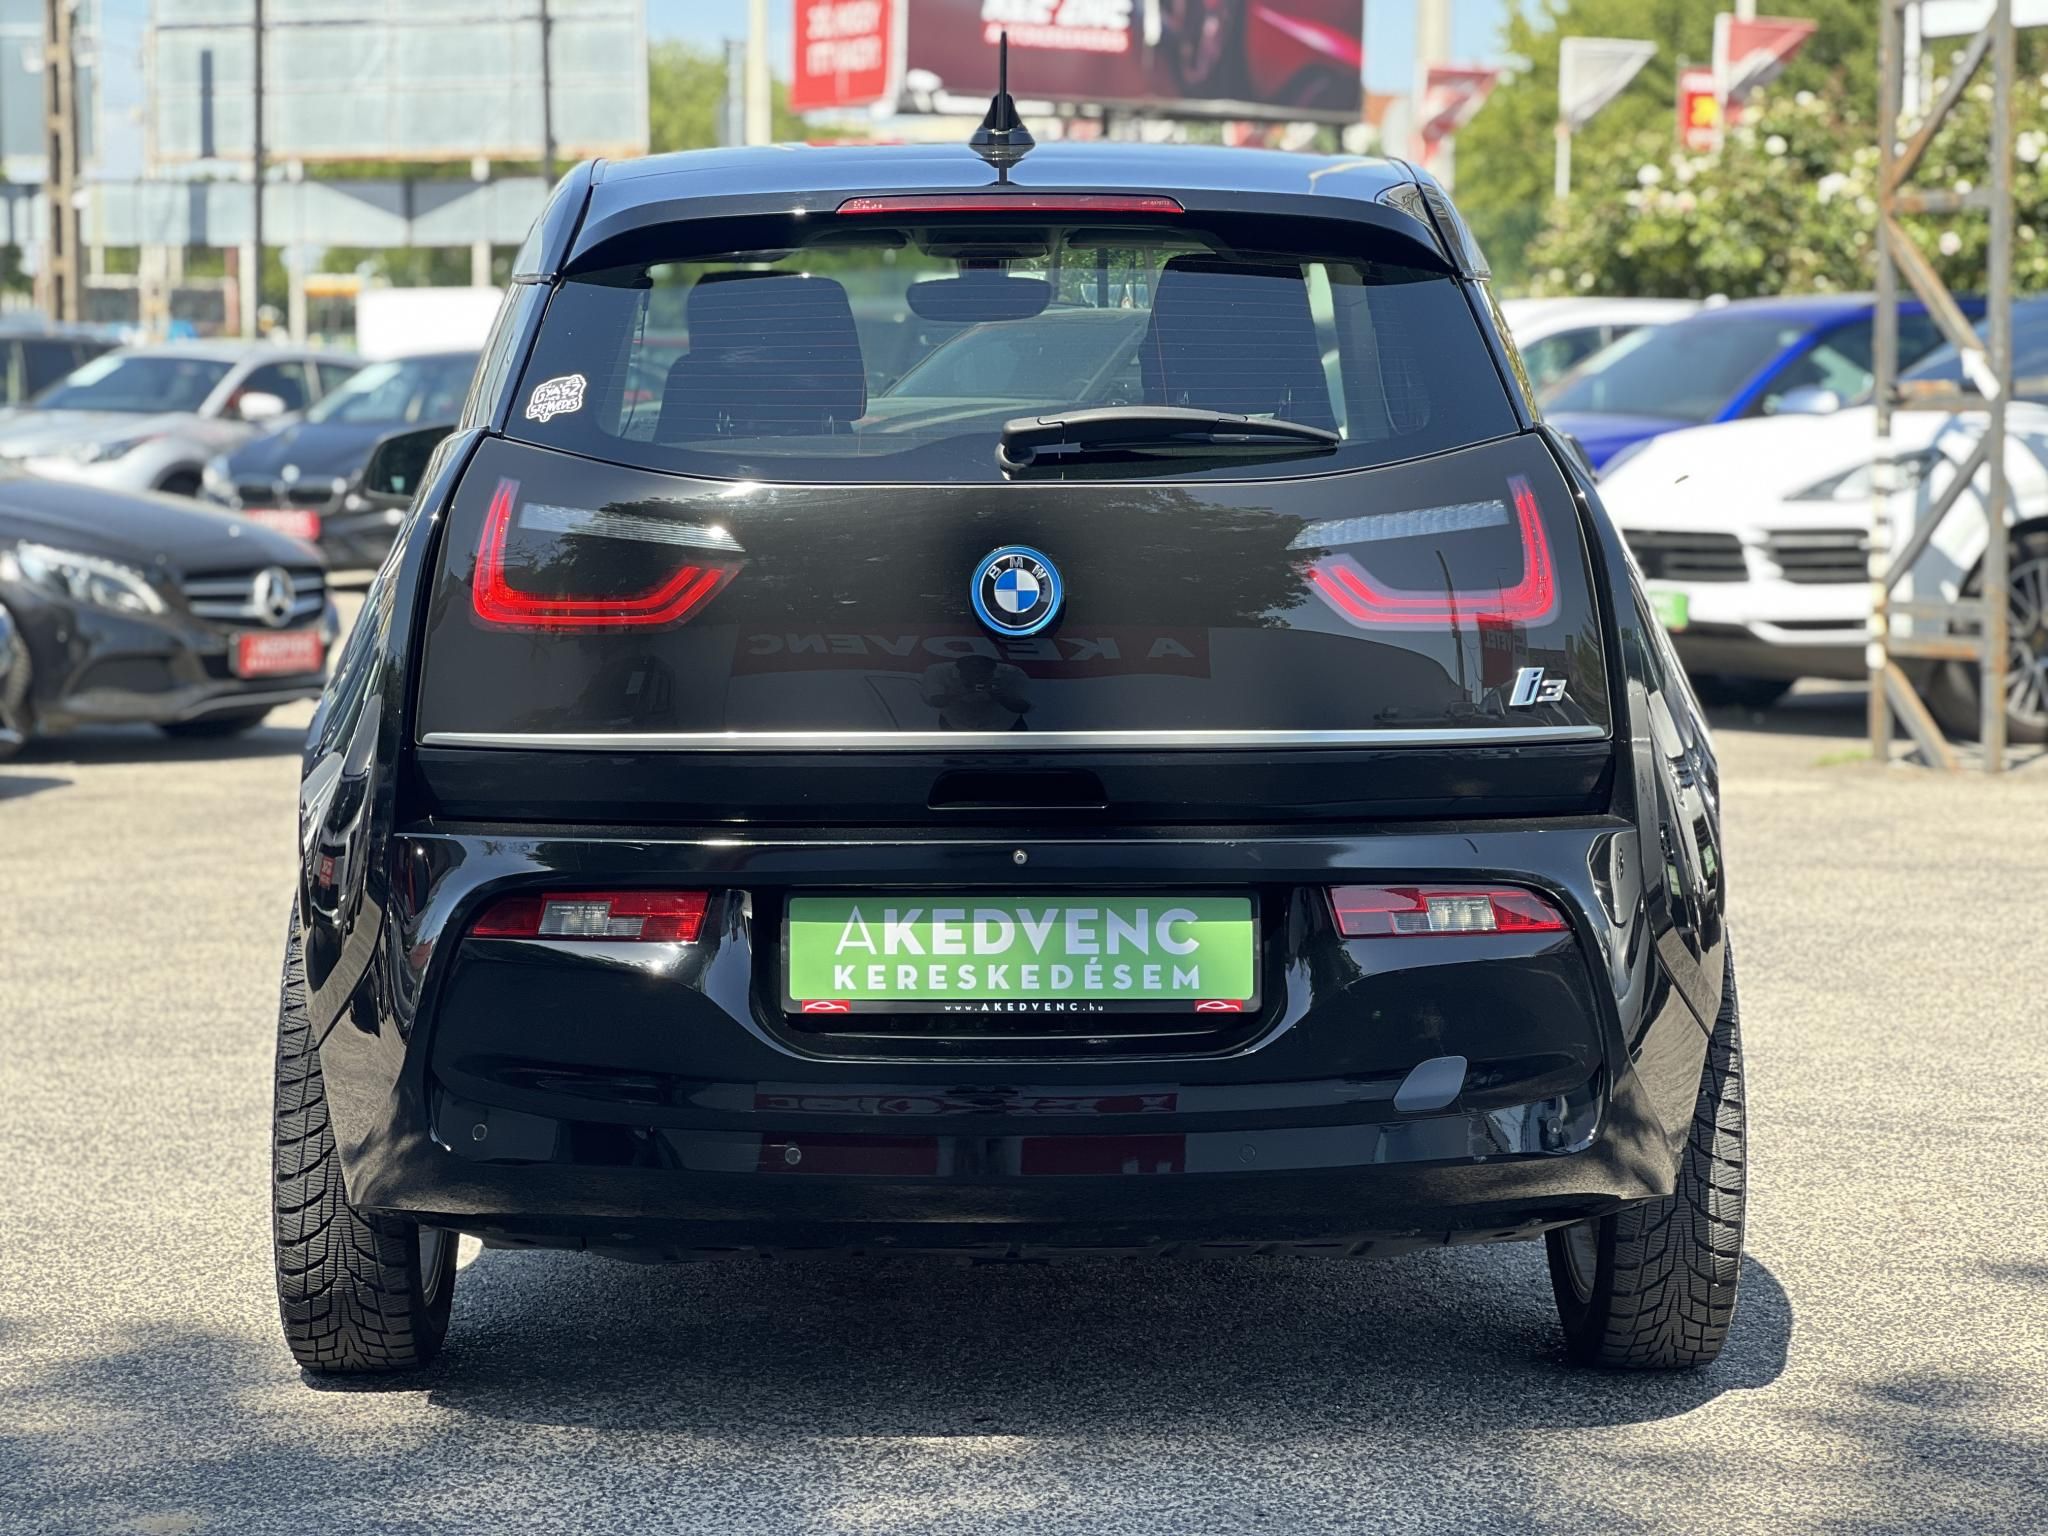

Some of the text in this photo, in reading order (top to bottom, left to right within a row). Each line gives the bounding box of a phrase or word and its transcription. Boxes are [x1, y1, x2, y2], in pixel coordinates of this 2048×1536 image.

[988, 556, 1047, 580] BMW
[1509, 667, 1567, 706] i3
[835, 905, 1200, 955] AKEDVENC
[834, 957, 1200, 990] KERESKEDÉSEM
[945, 1002, 1104, 1012] www.AKEDVENC.hu
